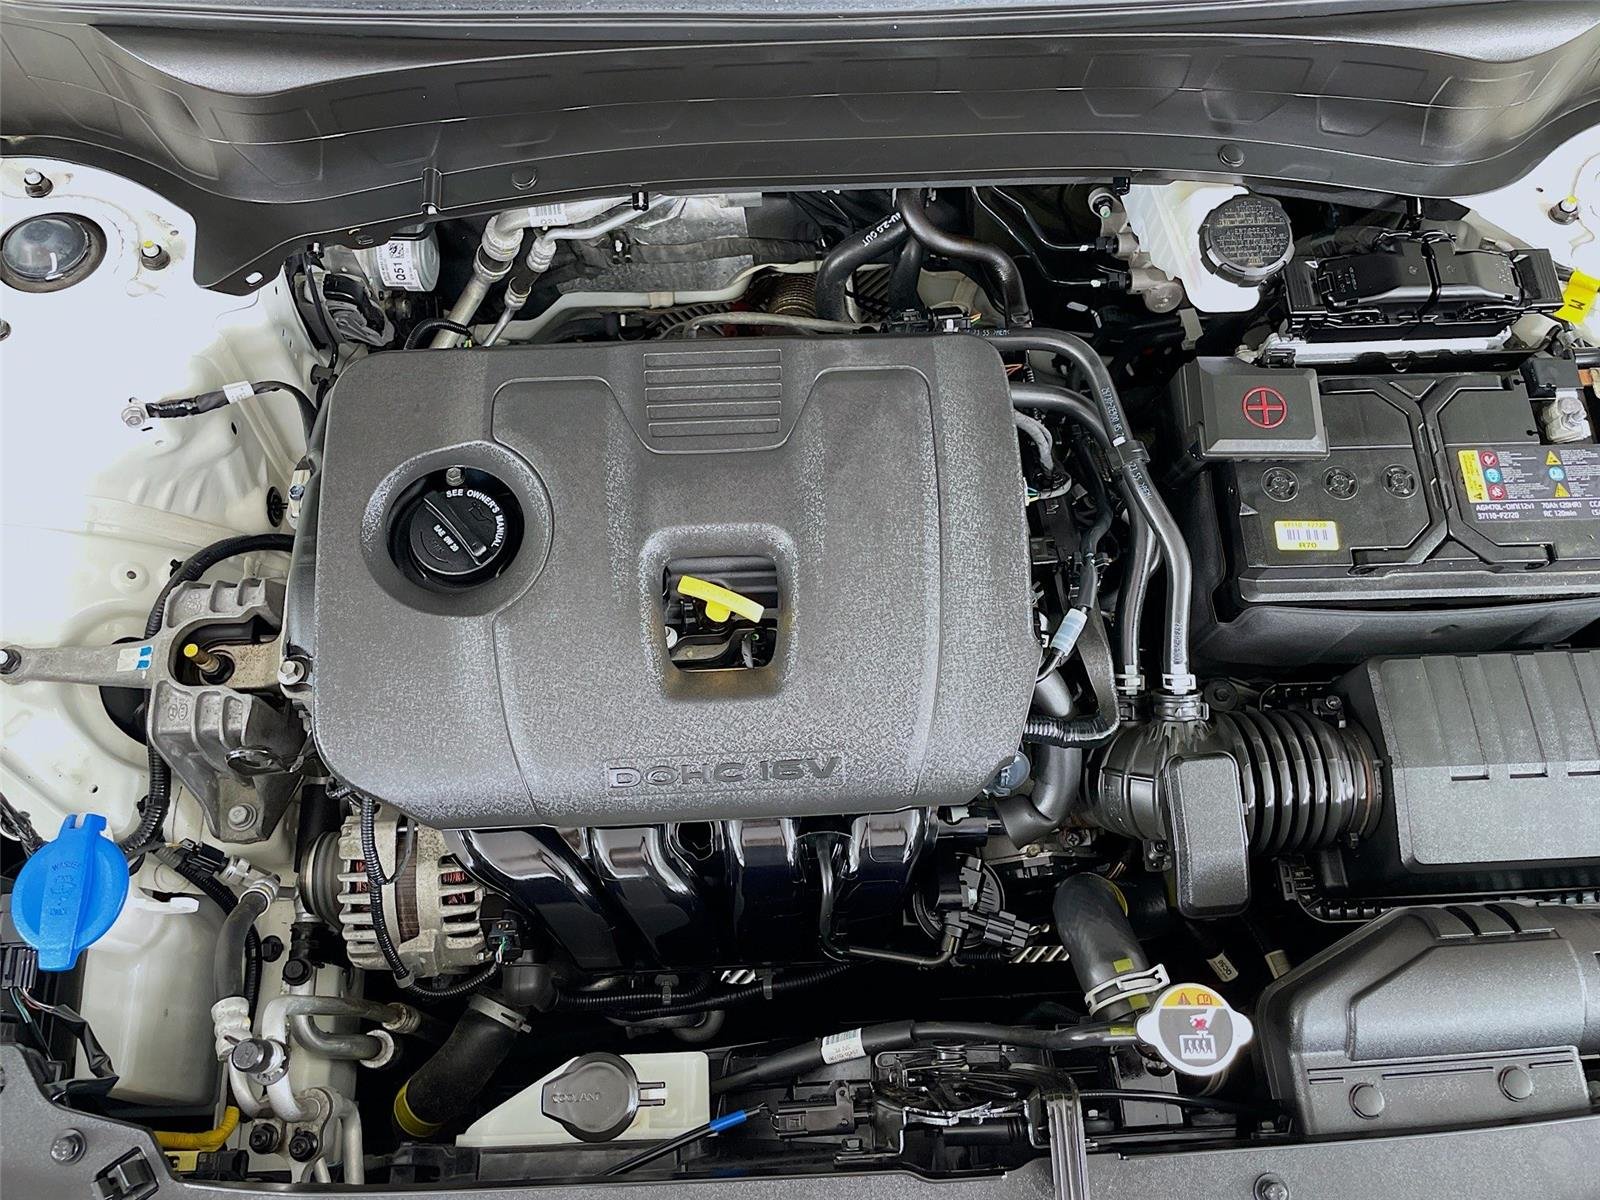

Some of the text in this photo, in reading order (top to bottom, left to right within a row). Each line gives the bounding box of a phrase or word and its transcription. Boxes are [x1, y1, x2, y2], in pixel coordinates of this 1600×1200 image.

[862, 230, 878, 248] OUT
[446, 489, 463, 497] SEE
[491, 515, 504, 547] MANUAL
[433, 524, 446, 538] SAE
[608, 756, 842, 788] DOHC 16V
[552, 1091, 601, 1104] COOLANT
